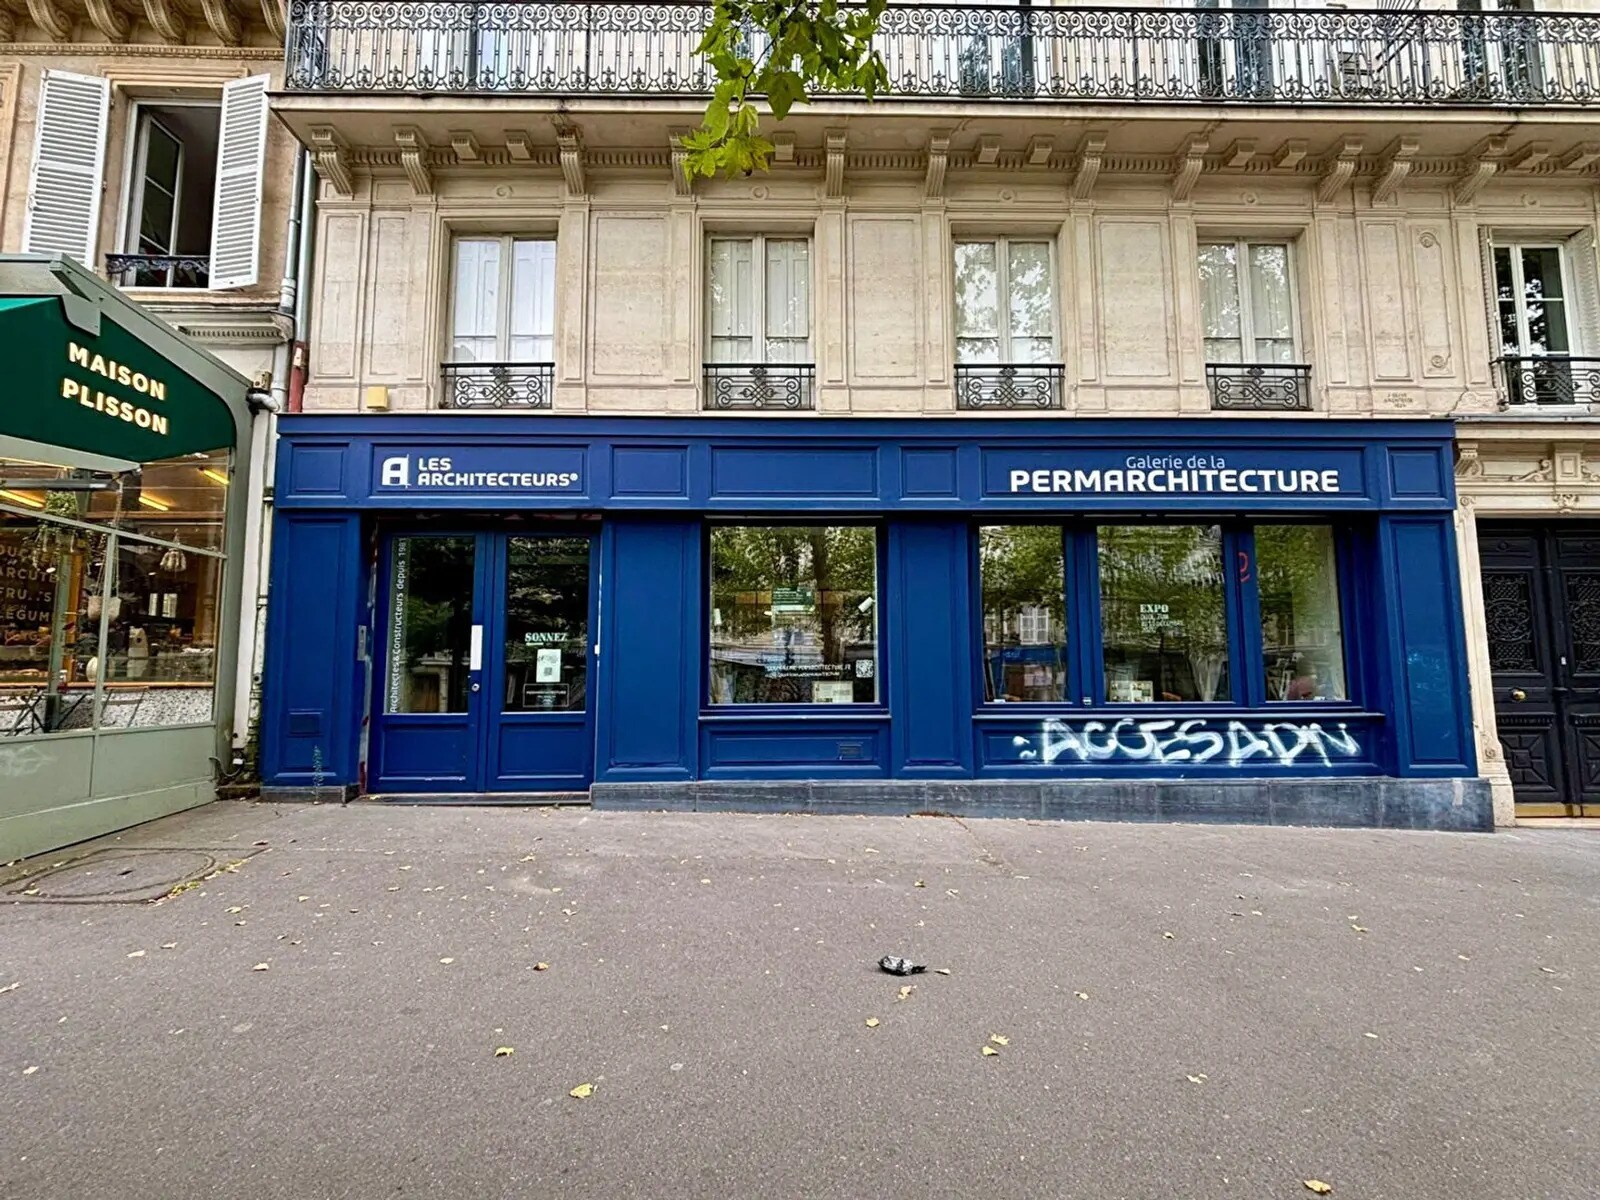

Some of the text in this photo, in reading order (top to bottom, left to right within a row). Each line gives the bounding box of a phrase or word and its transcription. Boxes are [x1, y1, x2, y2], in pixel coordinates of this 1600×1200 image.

[69, 341, 165, 401] MAISON
[62, 377, 168, 435] PLISSON
[418, 457, 451, 471] LES
[1126, 455, 1226, 469] Galerie de la
[1010, 469, 1340, 493] PERMARCHITECTURE
[396, 560, 405, 590] depuis
[1140, 604, 1169, 613] EXPO
[525, 632, 568, 642] SONNEZ
